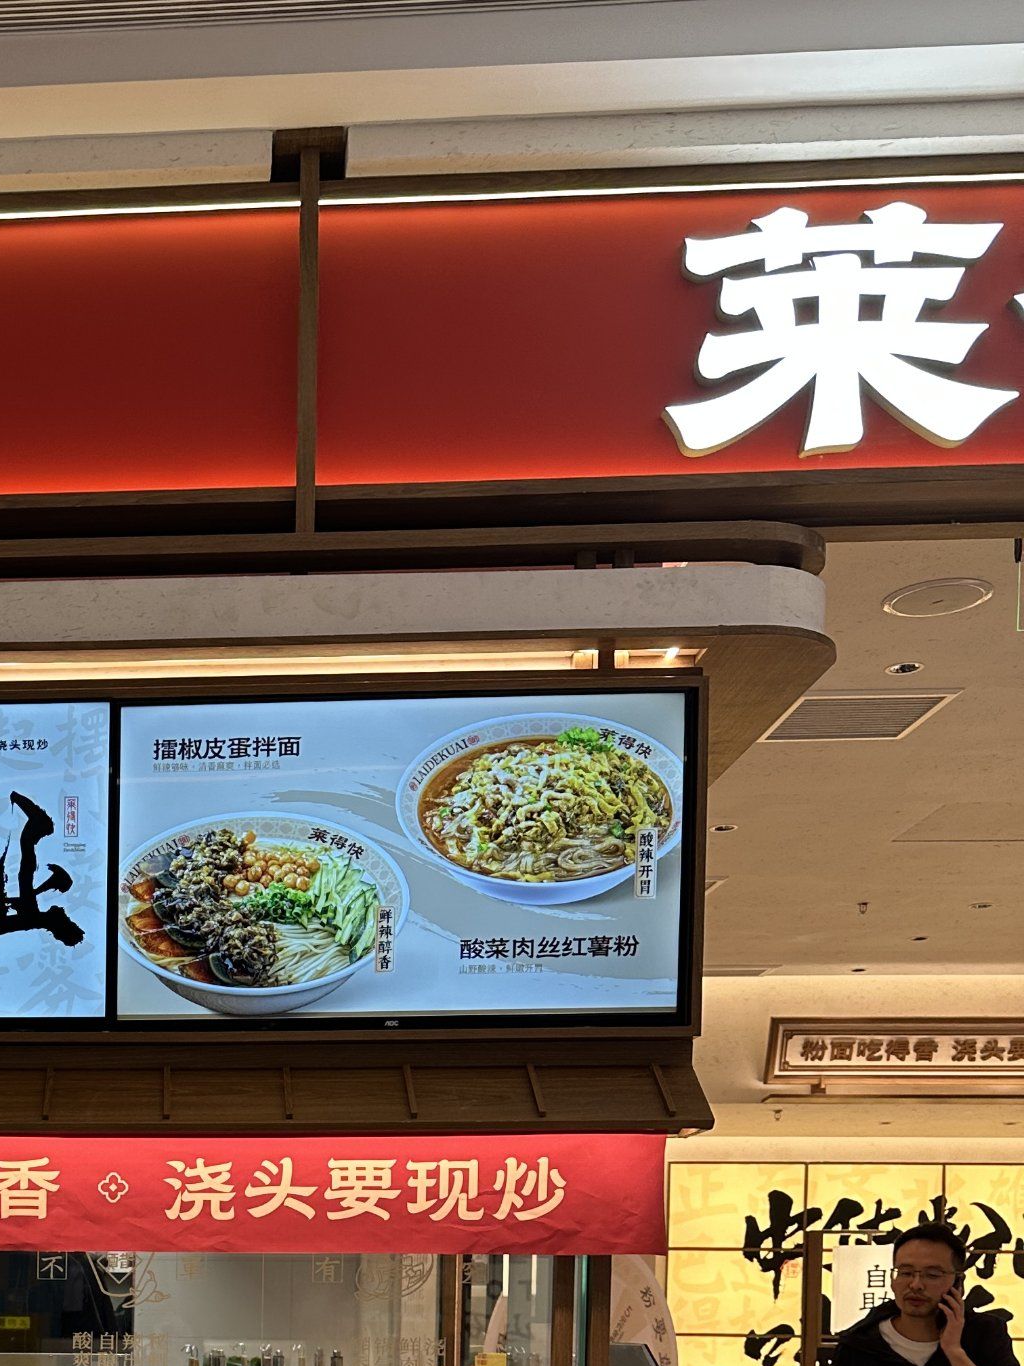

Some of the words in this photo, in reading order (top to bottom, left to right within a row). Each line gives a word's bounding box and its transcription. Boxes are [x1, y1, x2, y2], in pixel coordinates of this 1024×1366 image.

[663, 202, 1024, 458] 莱
[153, 736, 302, 761] 擂椒皮蛋拌面
[599, 728, 653, 759] 莱得快
[414, 738, 469, 786] LAIDEKUAI
[308, 827, 365, 860] 莱得快
[638, 832, 654, 895] 酸辣开胃
[459, 935, 640, 960] 酸菜肉丝红薯粉
[800, 1036, 940, 1062] 粉面吃得香
[163, 1156, 568, 1222] 浇头要现炒
